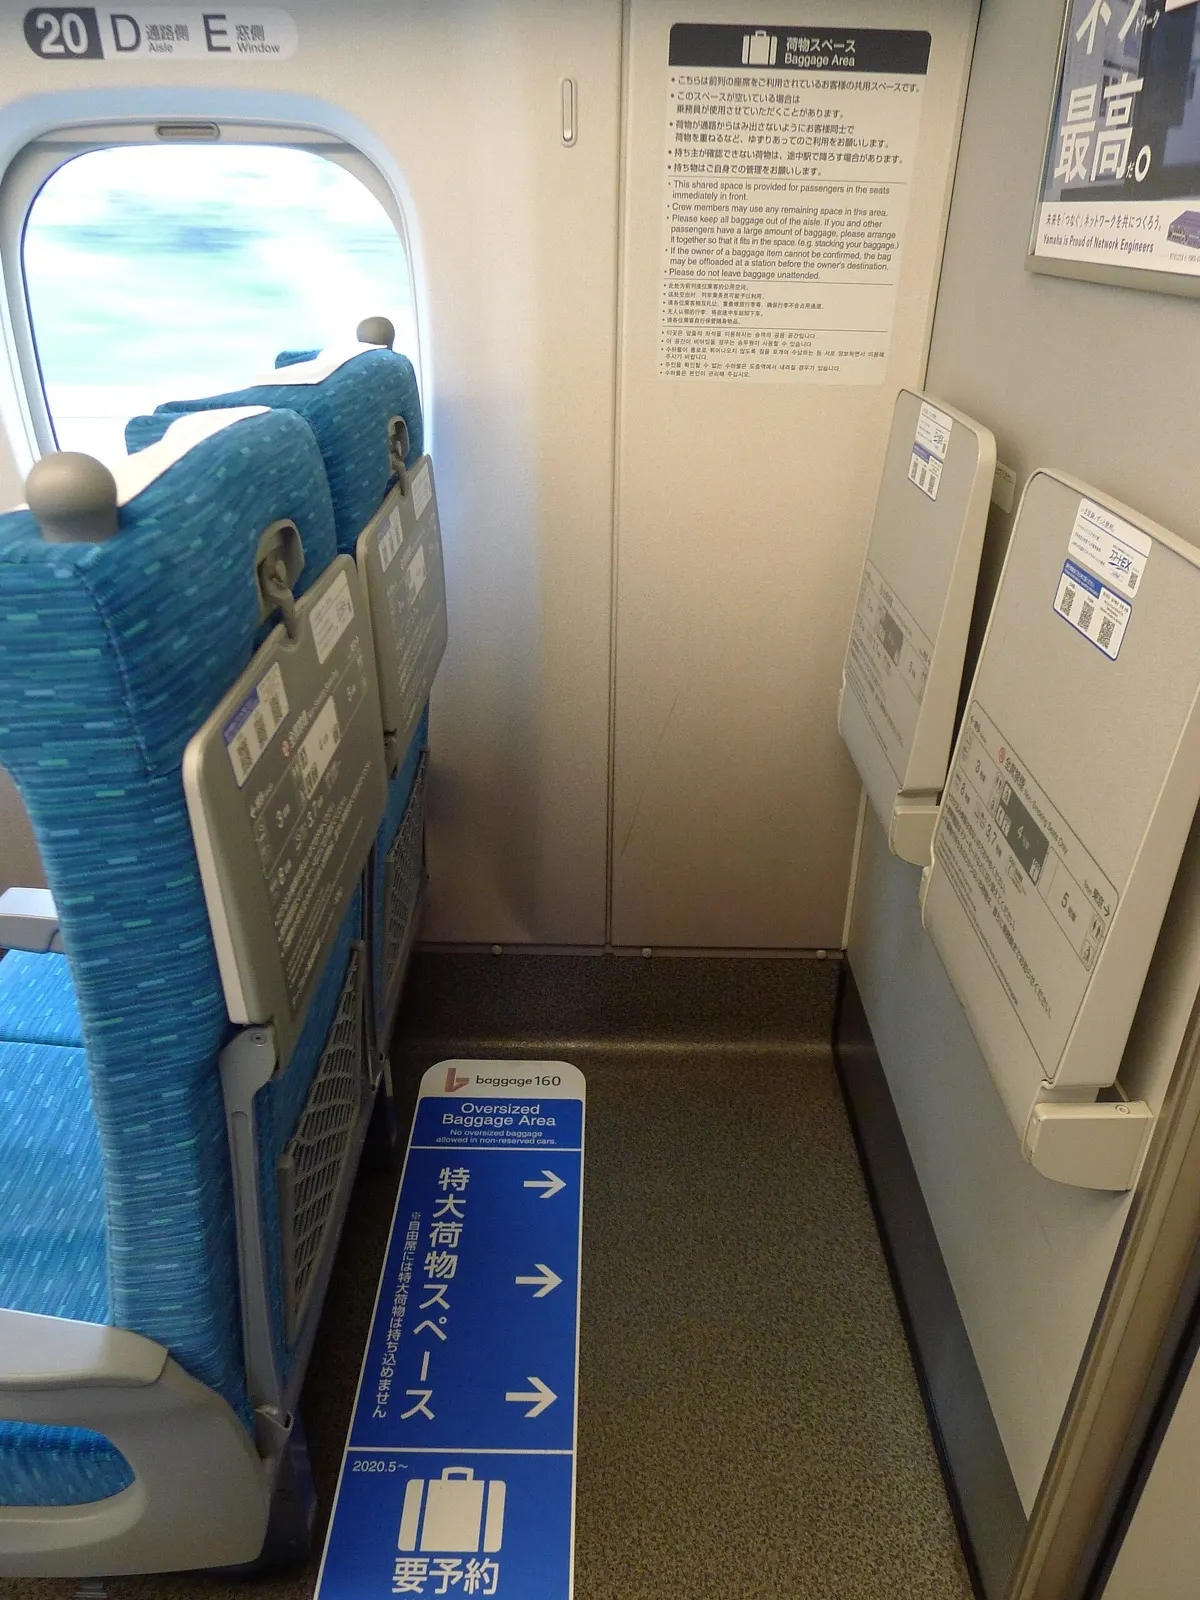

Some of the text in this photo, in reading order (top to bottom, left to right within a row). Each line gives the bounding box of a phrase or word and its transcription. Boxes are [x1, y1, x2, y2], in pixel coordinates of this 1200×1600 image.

[35, 13, 141, 54] 20 D
[146, 24, 190, 42] 通路側
[202, 14, 231, 52] E
[149, 42, 173, 53] Aisle
[237, 42, 280, 53] Window
[786, 37, 856, 54] 荷物スペース
[784, 53, 855, 68] Baggage Area
[674, 180, 689, 189] This
[691, 180, 718, 189] shared
[720, 183, 743, 192] space
[753, 182, 786, 193] provided
[800, 185, 844, 195] passengers
[869, 185, 889, 194] seats
[672, 190, 718, 201] immediately
[728, 191, 748, 200] front.
[672, 201, 692, 210] Crew
[694, 202, 729, 211] members
[780, 205, 818, 216] remaining
[820, 208, 842, 217] space
[853, 207, 867, 216] this
[672, 213, 698, 222] Please
[699, 214, 718, 225] keep
[730, 215, 764, 226] baggage
[802, 217, 822, 226] aisle.
[862, 219, 882, 227] other
[670, 226, 714, 236] passengers
[716, 225, 734, 234] have
[743, 226, 762, 237] large
[764, 226, 792, 235] amount
[803, 227, 838, 239] baggage,
[840, 228, 865, 239] please
[866, 231, 896, 240] arrange
[676, 235, 706, 246] together
[718, 236, 732, 244] that
[739, 236, 750, 245] fits
[773, 239, 796, 248] space.
[797, 238, 812, 249] (e.g.
[814, 238, 844, 250] stacking
[845, 241, 862, 250] your
[862, 240, 899, 251] baggage.)
[1043, 234, 1154, 254] Yamaha is Proud of Network Engineers
[731, 247, 764, 258] baggage
[766, 248, 782, 257] item
[784, 248, 809, 257] cannot
[822, 249, 861, 261] confirmed,
[698, 257, 733, 266] offloaded
[751, 258, 776, 267] station
[777, 259, 801, 268] before
[816, 260, 845, 269] owner's
[846, 261, 888, 270] destination.
[668, 267, 694, 276] Please
[721, 268, 741, 277] leave
[742, 269, 775, 280] baggage
[777, 270, 820, 279] unattended.
[461, 1102, 540, 1115] Oversized
[442, 1113, 556, 1127] Baggage Area
[436, 1136, 468, 1144] allowed
[400, 1167, 470, 1420] 特大荷物スペース
[391, 1557, 499, 1595] 要予約
